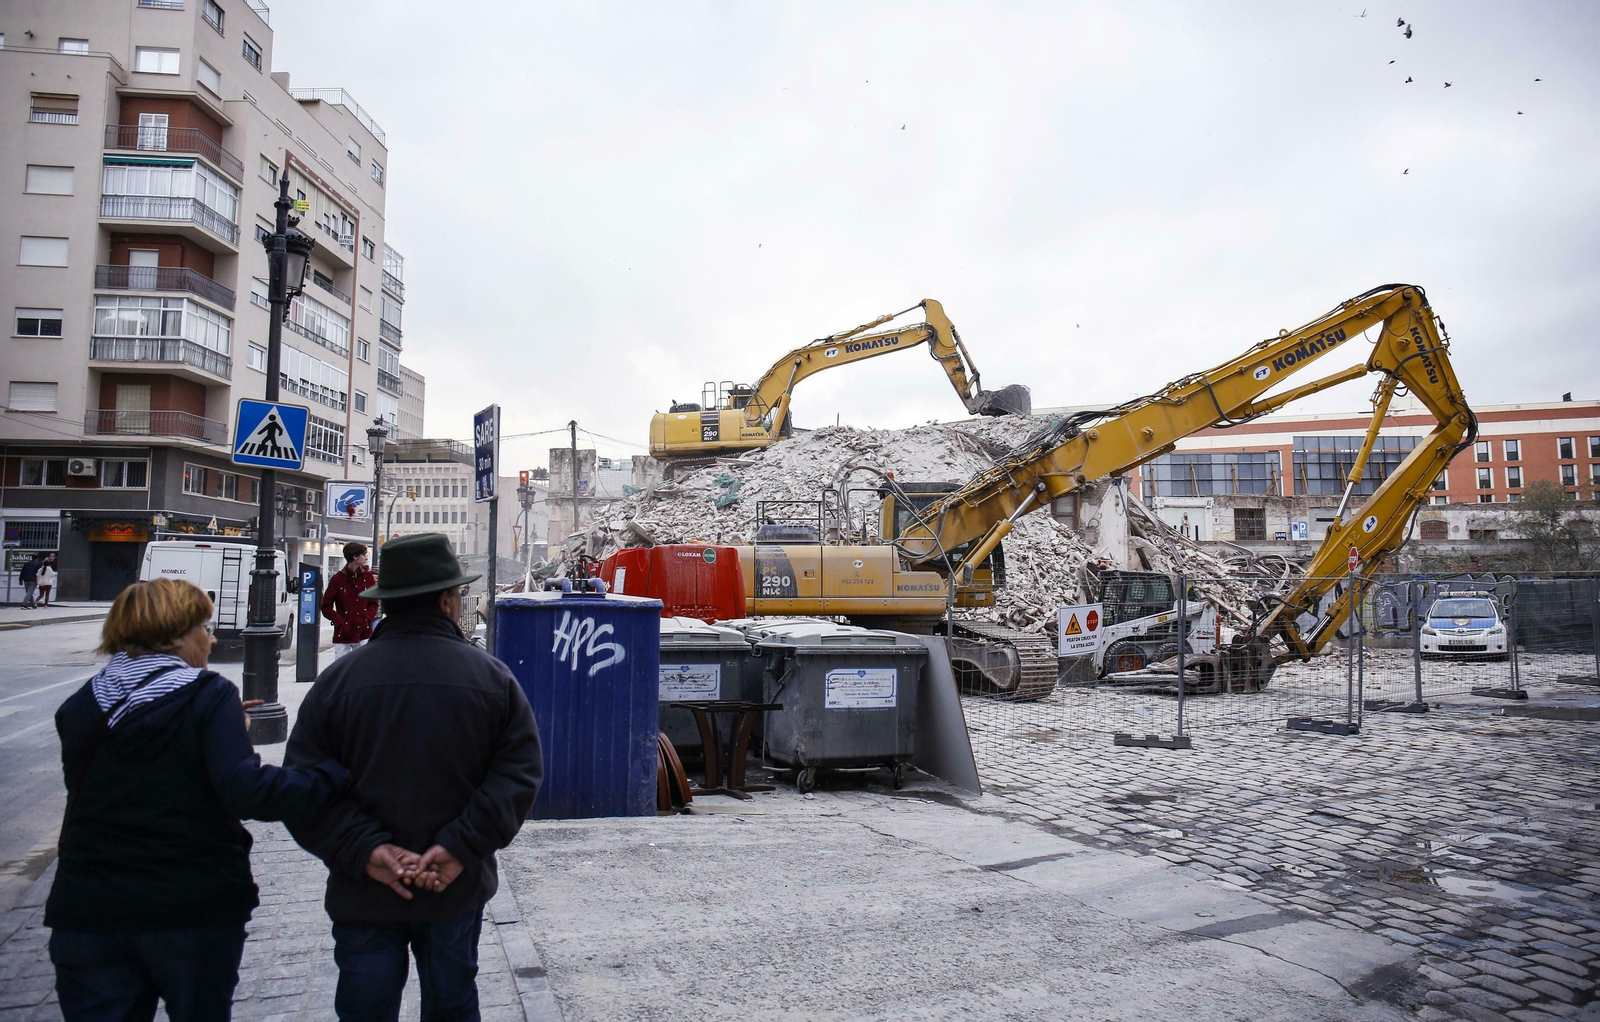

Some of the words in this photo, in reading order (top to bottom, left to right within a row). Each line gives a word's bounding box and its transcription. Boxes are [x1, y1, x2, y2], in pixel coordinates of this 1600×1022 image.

[844, 336, 899, 353] KOMATSU
[1272, 328, 1346, 372] KOMATSU
[1409, 326, 1438, 384] KOMATSU
[1255, 368, 1268, 378] FT
[476, 418, 494, 448] SARE
[762, 566, 777, 575] PC
[304, 572, 312, 584] P
[762, 576, 790, 587] 290
[897, 583, 940, 592] KOMATSU
[672, 604, 718, 618] Haulotte
[552, 610, 626, 676] HPS
